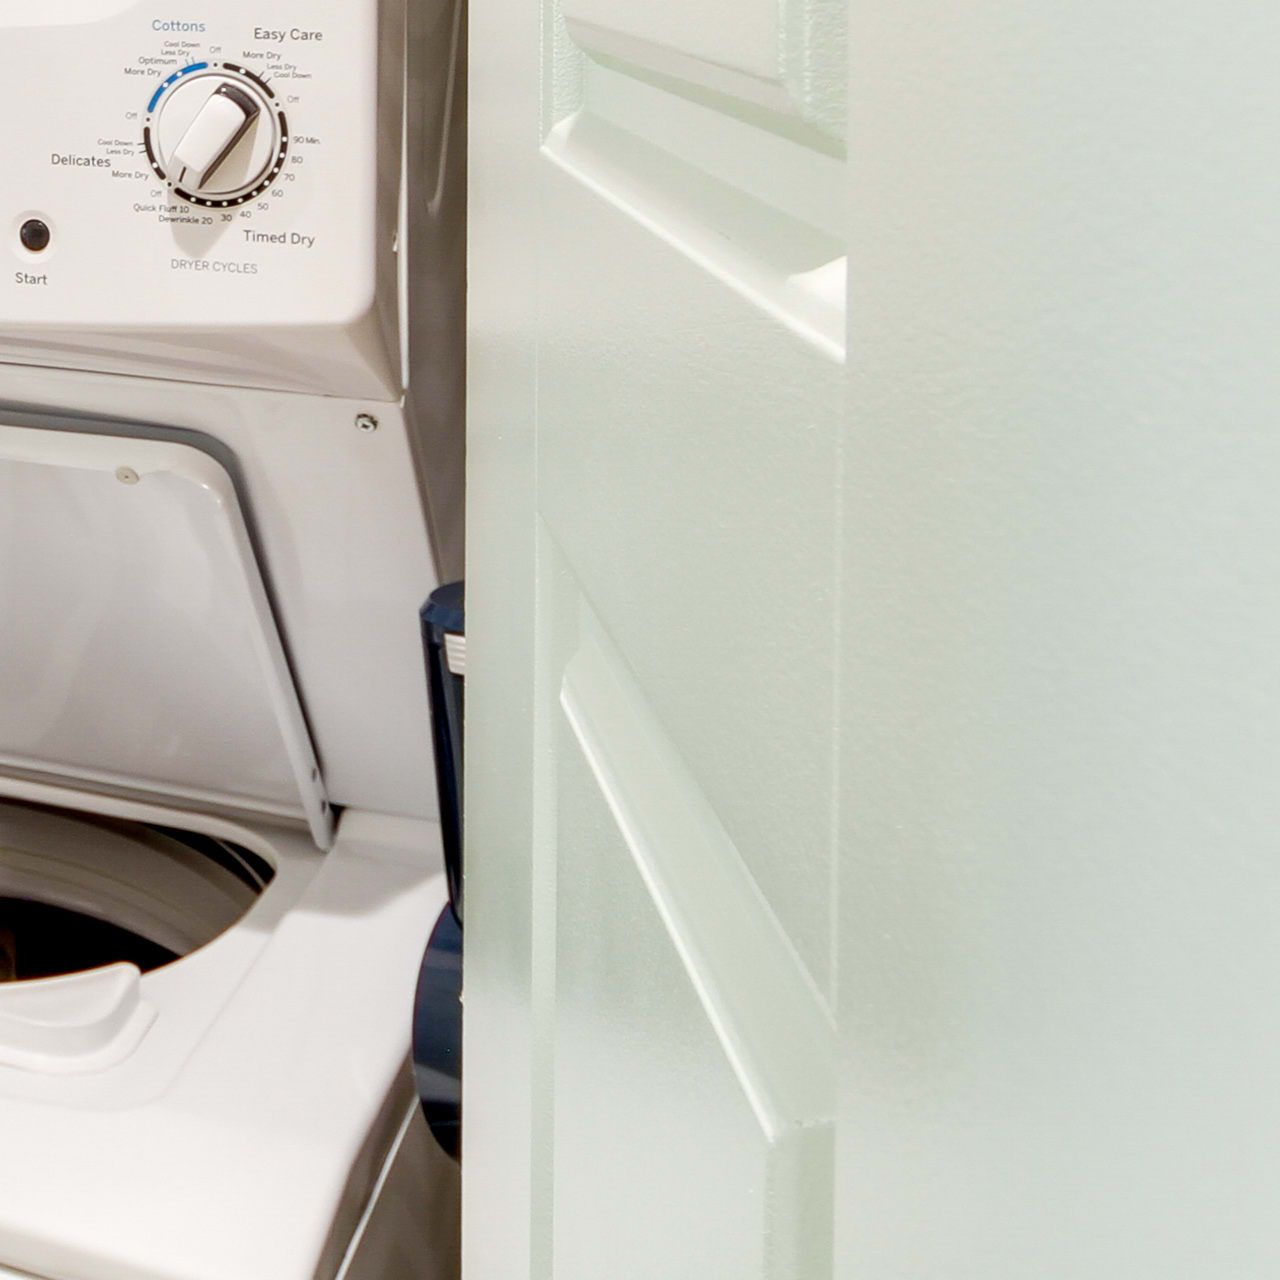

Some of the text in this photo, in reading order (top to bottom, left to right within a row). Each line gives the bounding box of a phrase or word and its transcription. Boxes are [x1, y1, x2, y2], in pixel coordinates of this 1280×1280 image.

[152, 19, 206, 32] Cottons
[254, 27, 323, 43] Easy Care
[177, 50, 190, 58] Dry
[209, 46, 222, 54] Off
[243, 51, 282, 60] More Dry
[138, 57, 177, 66] Optimum
[284, 64, 297, 72] Dry
[124, 68, 162, 78] More Dry
[287, 96, 300, 104] Off
[125, 112, 138, 120] Off
[293, 136, 304, 144] 90
[123, 149, 135, 157] Dry
[51, 153, 111, 168] Delicates
[291, 156, 303, 164] 80
[111, 170, 149, 180] More Dry
[150, 190, 162, 198] Off
[272, 189, 284, 197] 60
[133, 203, 156, 212] Quick
[159, 205, 178, 213] Fluff
[258, 203, 269, 211] 50
[221, 214, 232, 222] 30
[240, 210, 252, 218] 40
[158, 215, 213, 225] Dewrinkle 20
[243, 229, 315, 249] Timed Dry
[171, 259, 258, 274] DRYER CYCLES
[15, 272, 47, 285] Start
